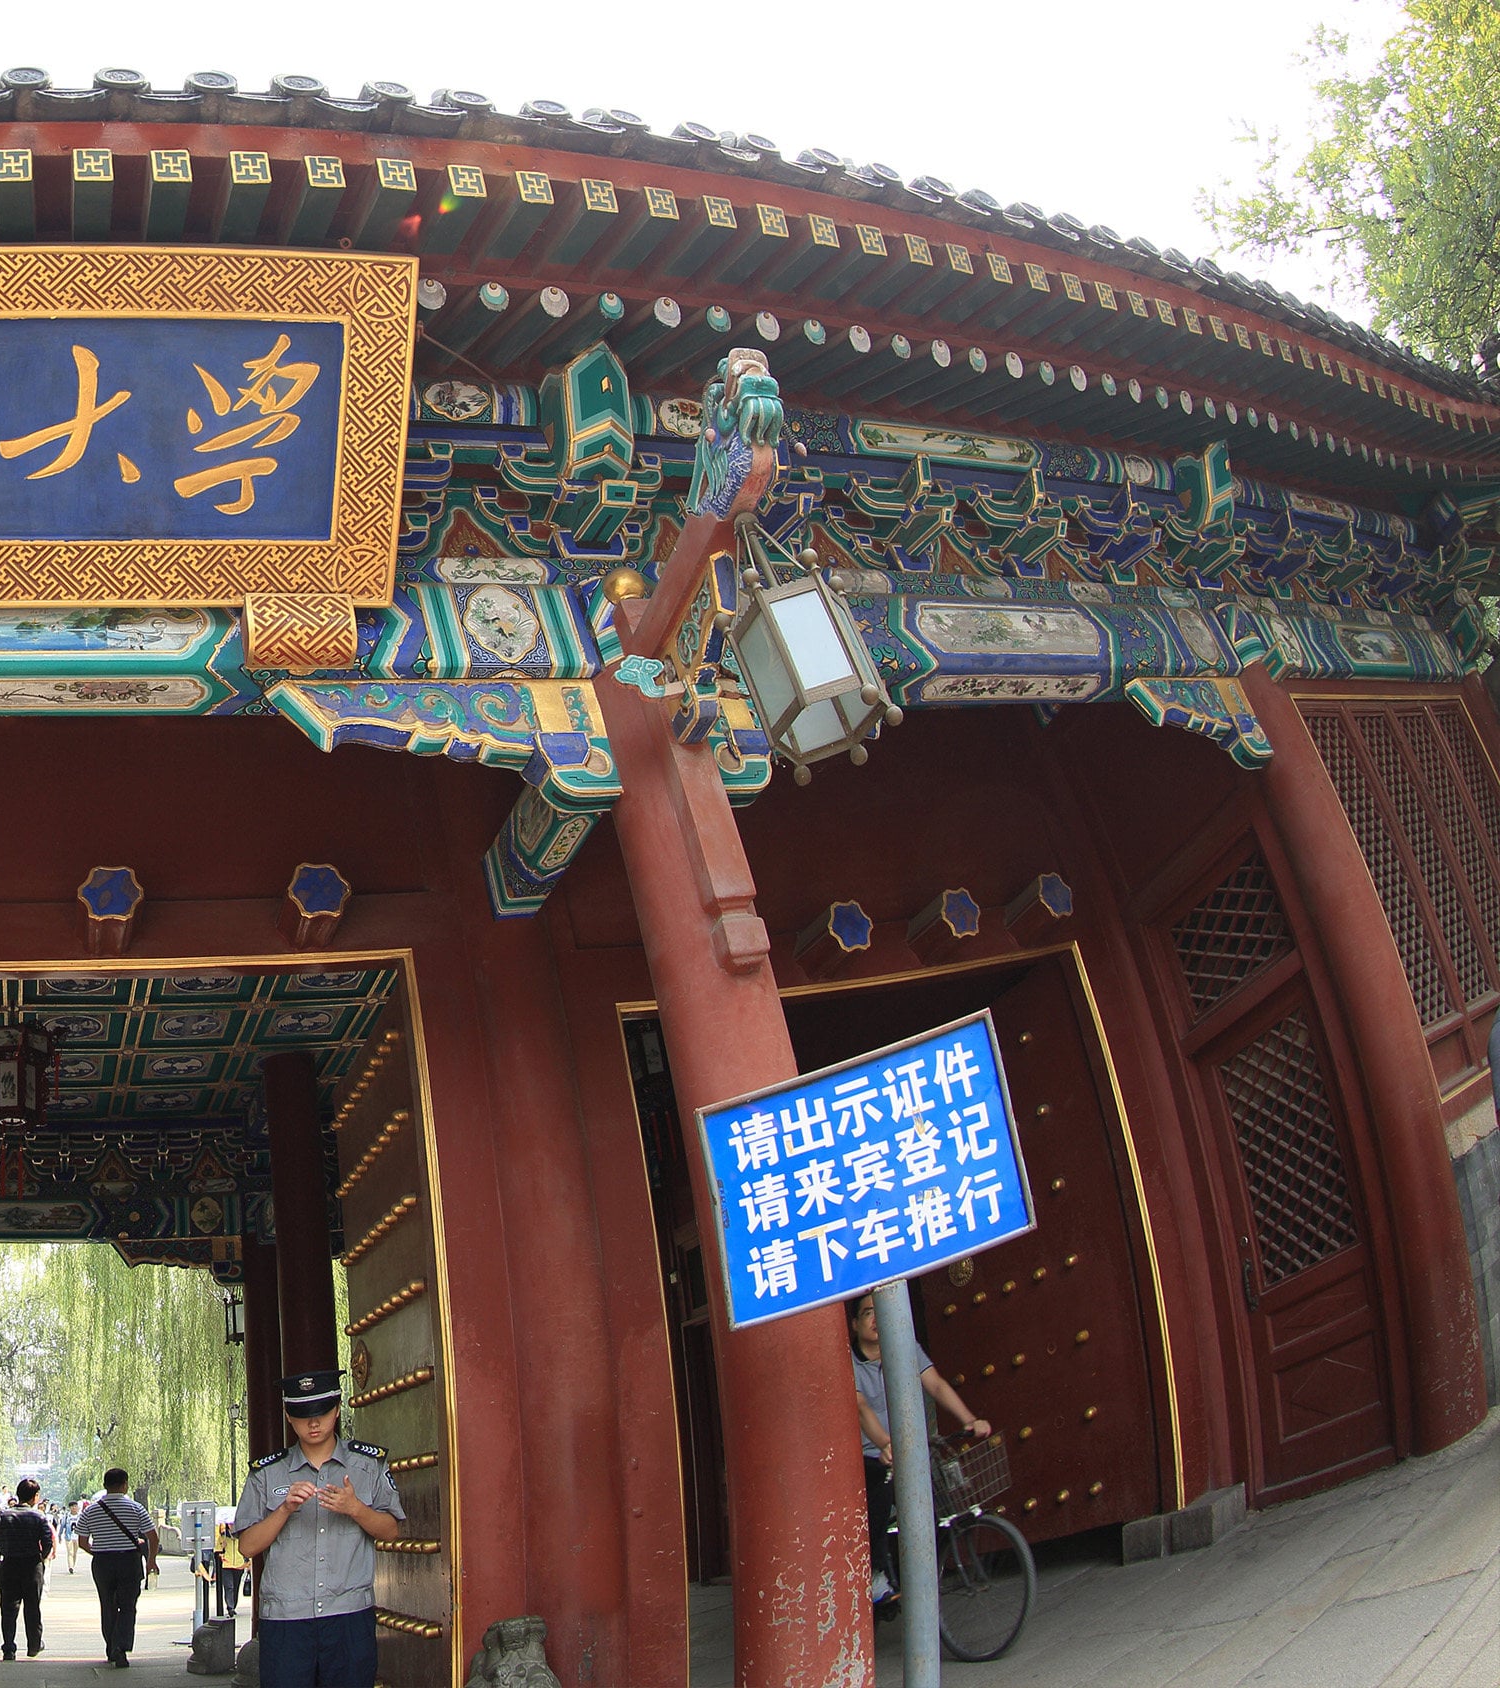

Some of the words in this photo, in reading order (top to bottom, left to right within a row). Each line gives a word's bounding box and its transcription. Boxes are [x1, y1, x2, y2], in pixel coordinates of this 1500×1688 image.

[727, 1041, 981, 1174] 请出示证件
[738, 1101, 999, 1235] 请来宾登记
[746, 1168, 1004, 1300] 请下车推行
